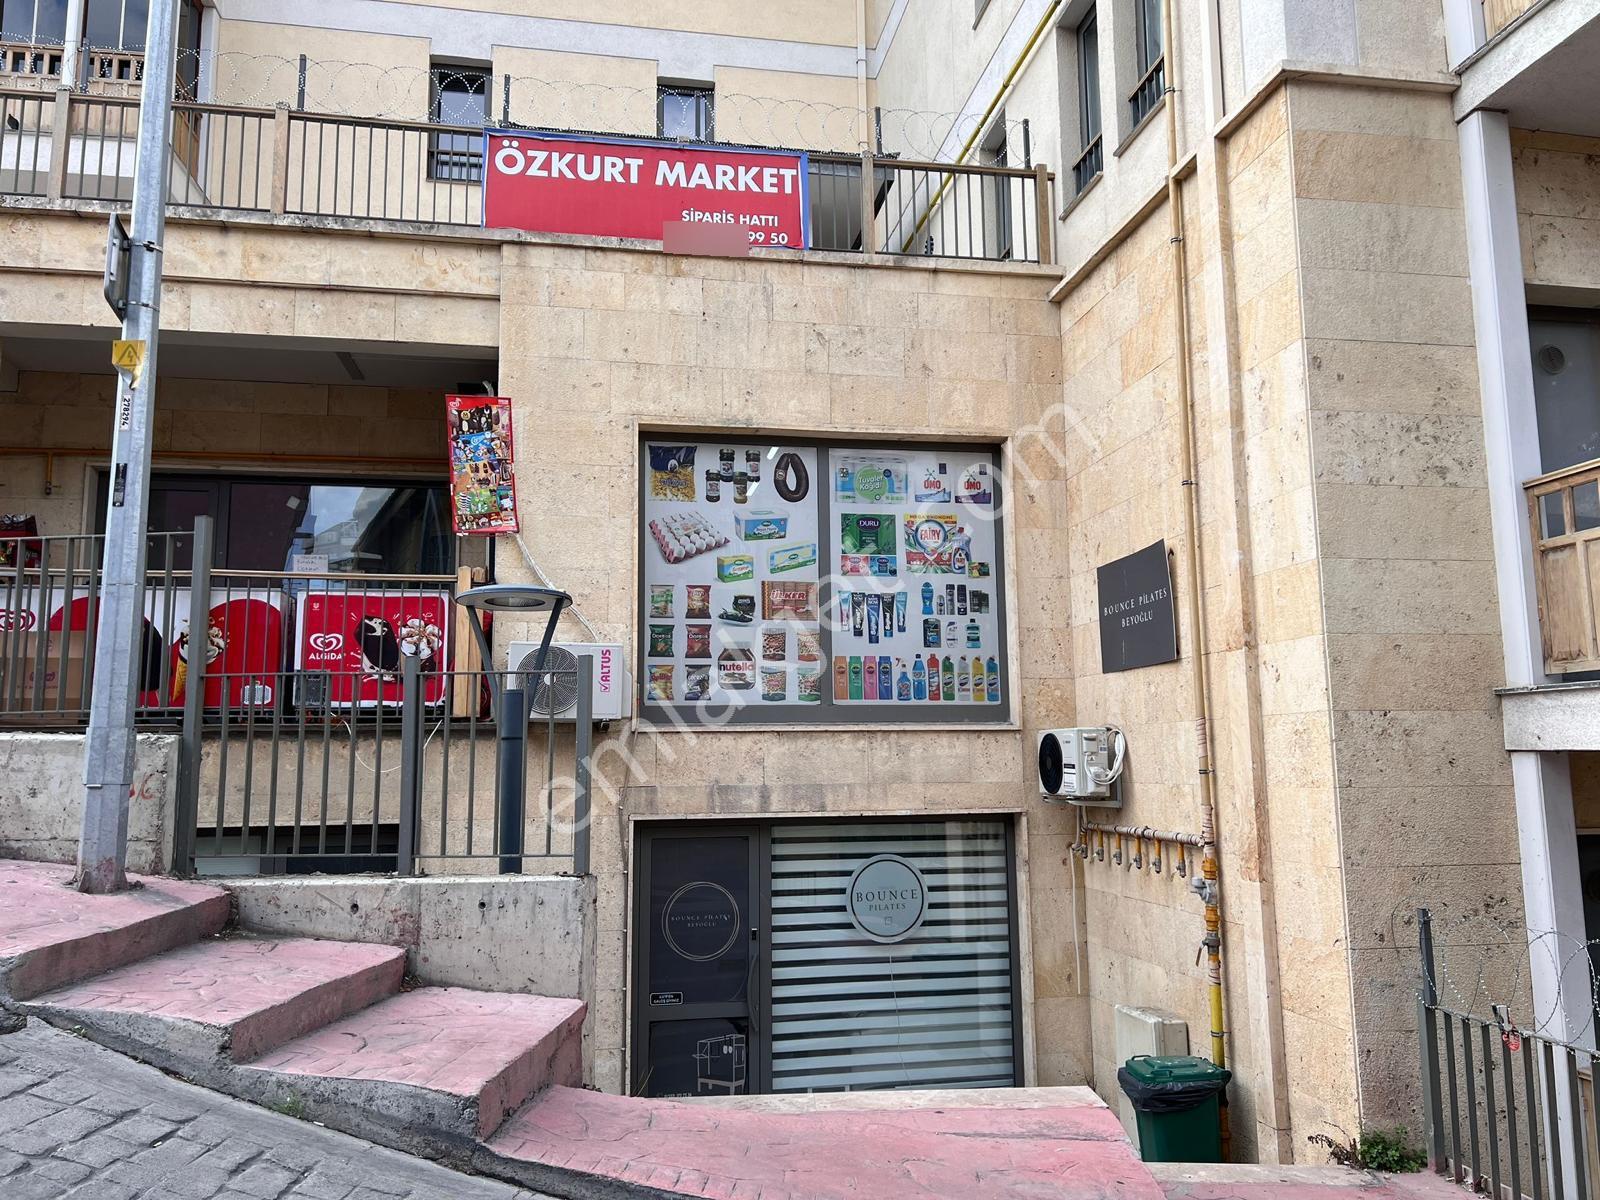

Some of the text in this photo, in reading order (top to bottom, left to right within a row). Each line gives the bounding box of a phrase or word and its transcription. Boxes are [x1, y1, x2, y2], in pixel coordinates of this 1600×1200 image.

[494, 139, 798, 194] ÖZKURT MARKET
[740, 214, 779, 227] HATTI
[770, 232, 788, 244] 50
[121, 397, 131, 427] 278294
[858, 472, 885, 485] Tuvalet
[923, 480, 941, 490] OMO
[963, 480, 981, 490] OMO
[770, 587, 807, 600] ÜLKER
[1103, 598, 1136, 617] BOUNCE
[1121, 609, 1153, 628] BEYOĞLU
[600, 649, 612, 682] ALTUS
[719, 661, 756, 672] nutella
[855, 888, 919, 903] BOUNCE
